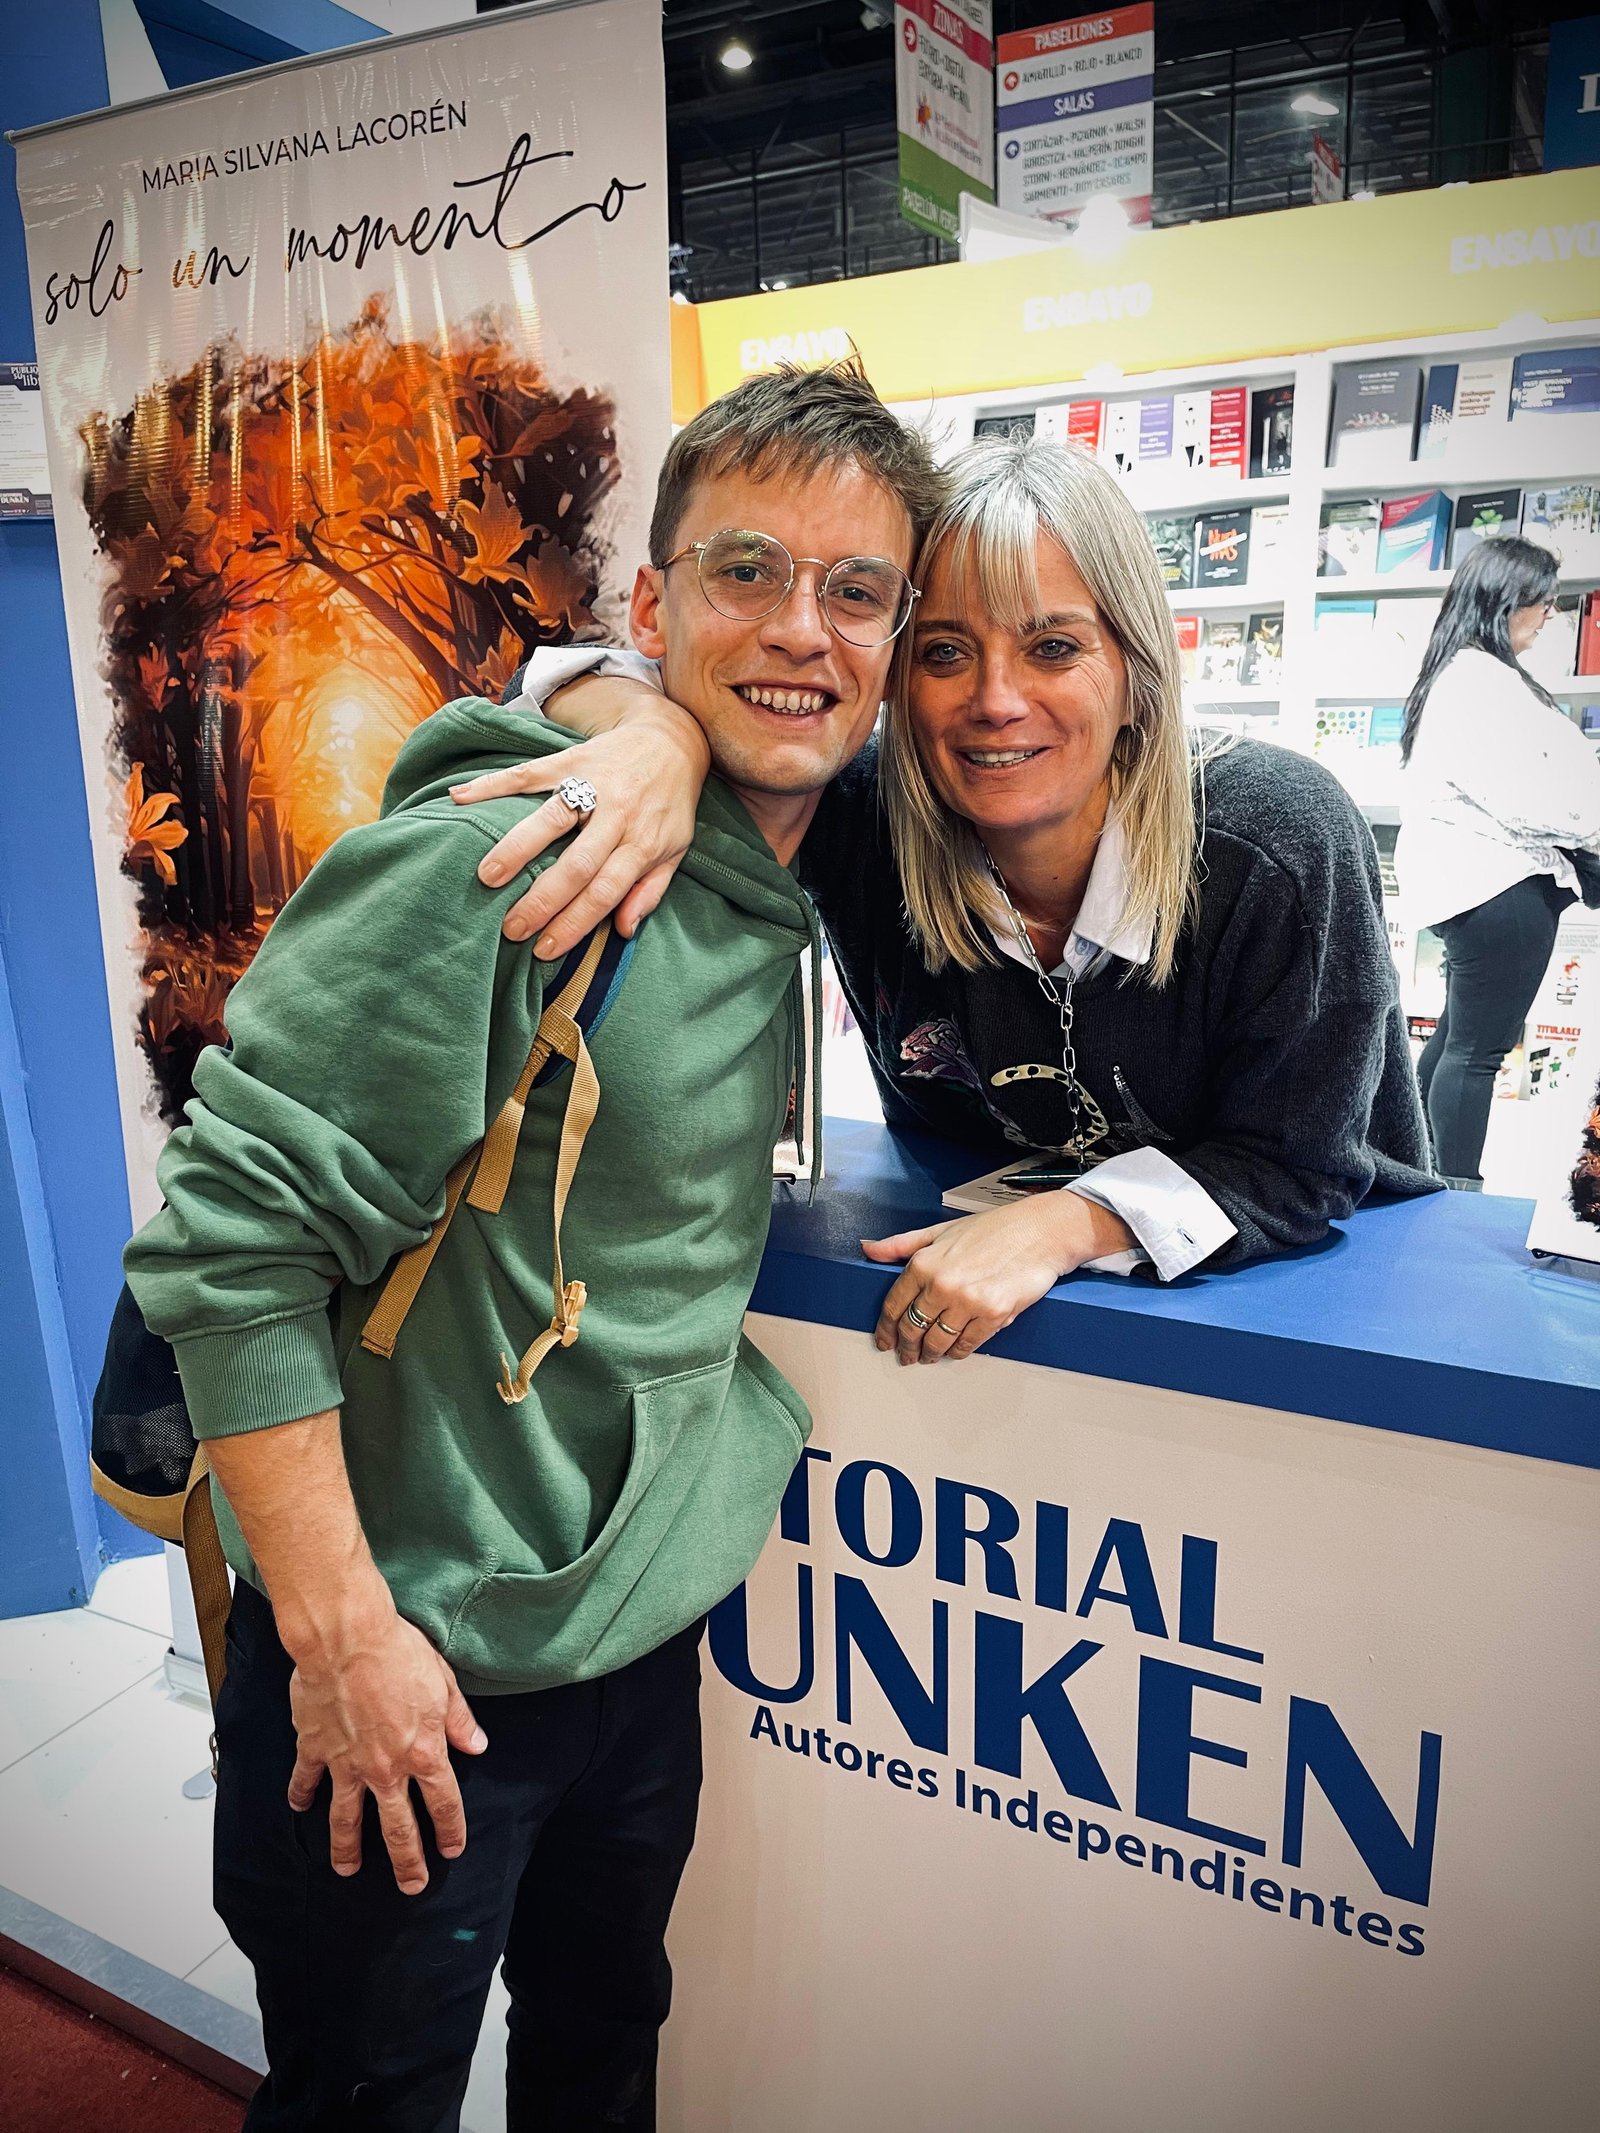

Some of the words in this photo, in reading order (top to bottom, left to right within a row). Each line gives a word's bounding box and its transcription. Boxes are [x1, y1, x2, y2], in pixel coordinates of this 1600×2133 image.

[1034, 17, 1115, 51] PABELLONES
[1053, 91, 1095, 117] SALAS
[142, 154, 220, 195] MARIA
[224, 131, 330, 177] SILVANA
[336, 98, 467, 152] LACORÉN
[45, 218, 143, 325] solo
[172, 244, 250, 290] un
[285, 132, 647, 274] momento
[1451, 219, 1600, 274] ENSAYO
[1023, 282, 1154, 333] ENSAYO
[740, 327, 850, 371] ENSAYO
[780, 1446, 1265, 1665] TORIAL
[707, 1563, 1442, 1908] UNKEN
[749, 1705, 939, 1798] Autores
[955, 1769, 1427, 1957] Independientes
